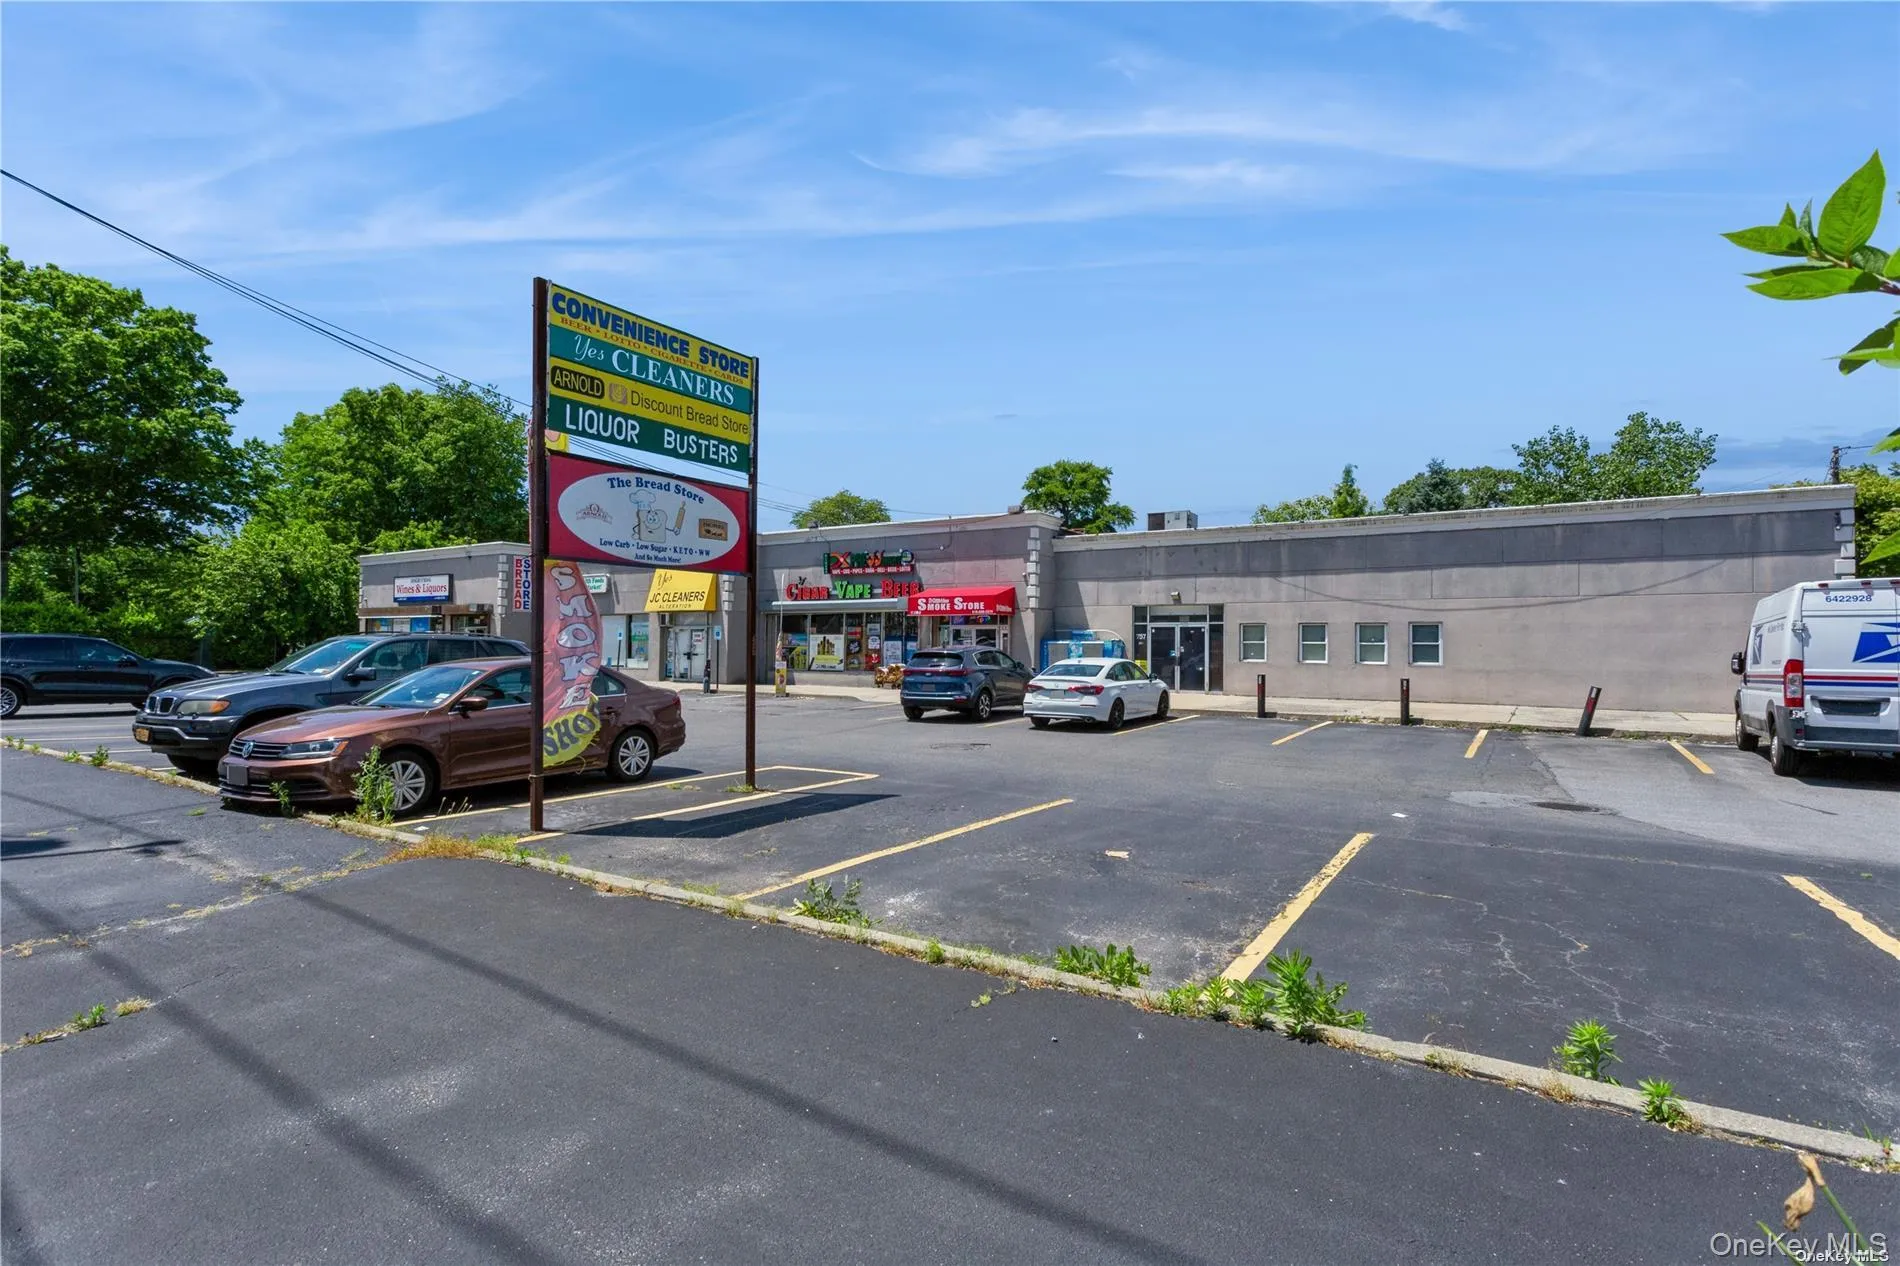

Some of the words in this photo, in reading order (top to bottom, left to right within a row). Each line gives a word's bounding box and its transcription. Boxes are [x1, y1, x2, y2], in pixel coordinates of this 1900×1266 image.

[552, 292, 690, 358] CONVENIENCE
[699, 346, 749, 378] STORE
[560, 317, 592, 334] BEER
[603, 331, 641, 349] LOTTO
[650, 347, 707, 372] CIGARETTE
[713, 369, 744, 385] CARDS
[574, 334, 604, 361] Yes
[612, 349, 734, 406] CLEANERS
[553, 368, 603, 397] ARNOLD
[631, 390, 683, 418] Discount
[686, 406, 719, 428] Bread
[722, 415, 749, 435] Store
[565, 403, 640, 444] LIQUOR
[663, 428, 738, 464] BUSTERS
[607, 477, 632, 488] The
[635, 477, 671, 492] Bread
[674, 484, 705, 504] Store
[599, 537, 613, 546] Low
[615, 539, 630, 549] Carb
[636, 542, 650, 550] Low
[651, 544, 668, 553] Sugar
[673, 546, 694, 555] KETO
[396, 584, 415, 594] Wines
[415, 584, 421, 593] &
[422, 583, 447, 595] Liquors
[514, 559, 522, 609] BREAD
[523, 559, 531, 610] STORE
[650, 592, 660, 603] JC
[662, 591, 705, 602] CLEANERS
[785, 583, 829, 601] CIGAR
[835, 580, 871, 598] VAPE
[881, 578, 919, 598] BEER
[918, 598, 951, 611] SMOKE
[954, 597, 985, 610] STORE
[1825, 595, 1872, 603] 6422928
[551, 566, 599, 710] SMOKE
